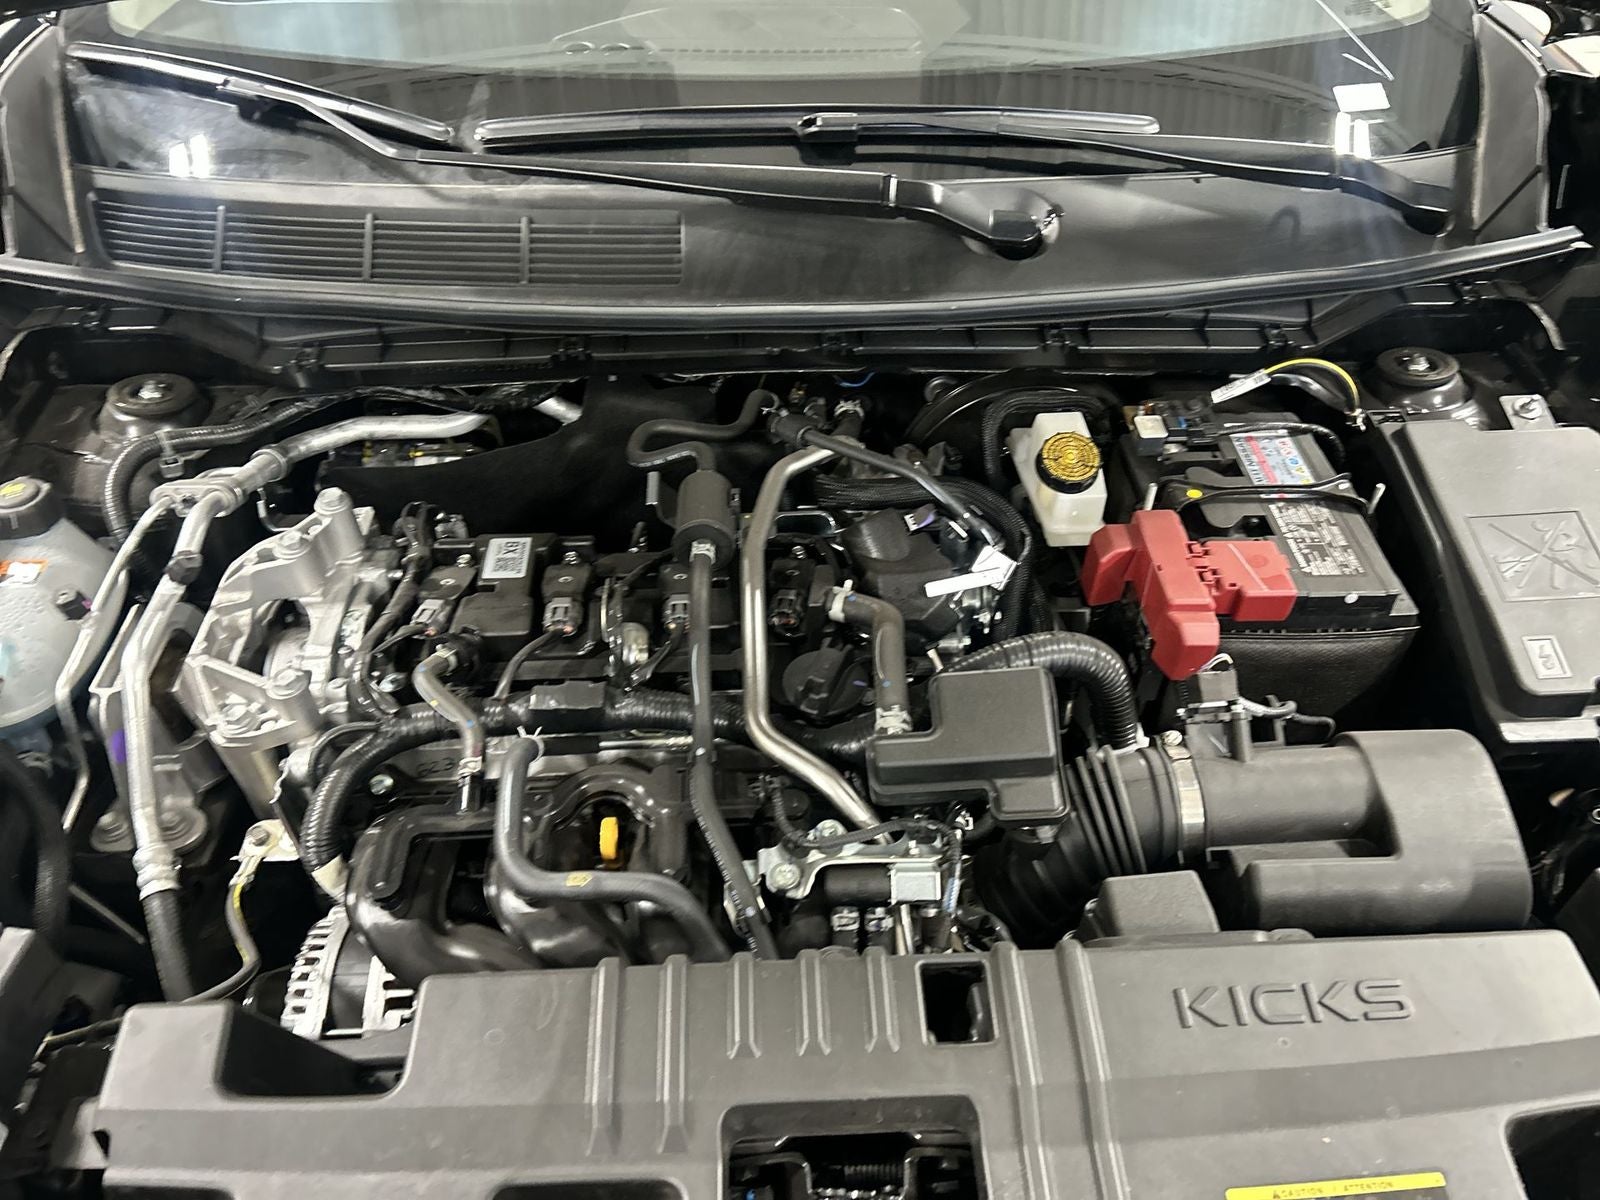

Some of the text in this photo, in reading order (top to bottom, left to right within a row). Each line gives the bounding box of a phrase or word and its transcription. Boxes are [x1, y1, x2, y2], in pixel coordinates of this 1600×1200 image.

[1173, 977, 1414, 1029] KICKS
[1281, 1187, 1323, 1198] CAUTION
[1344, 1181, 1393, 1192] ATTENTION
